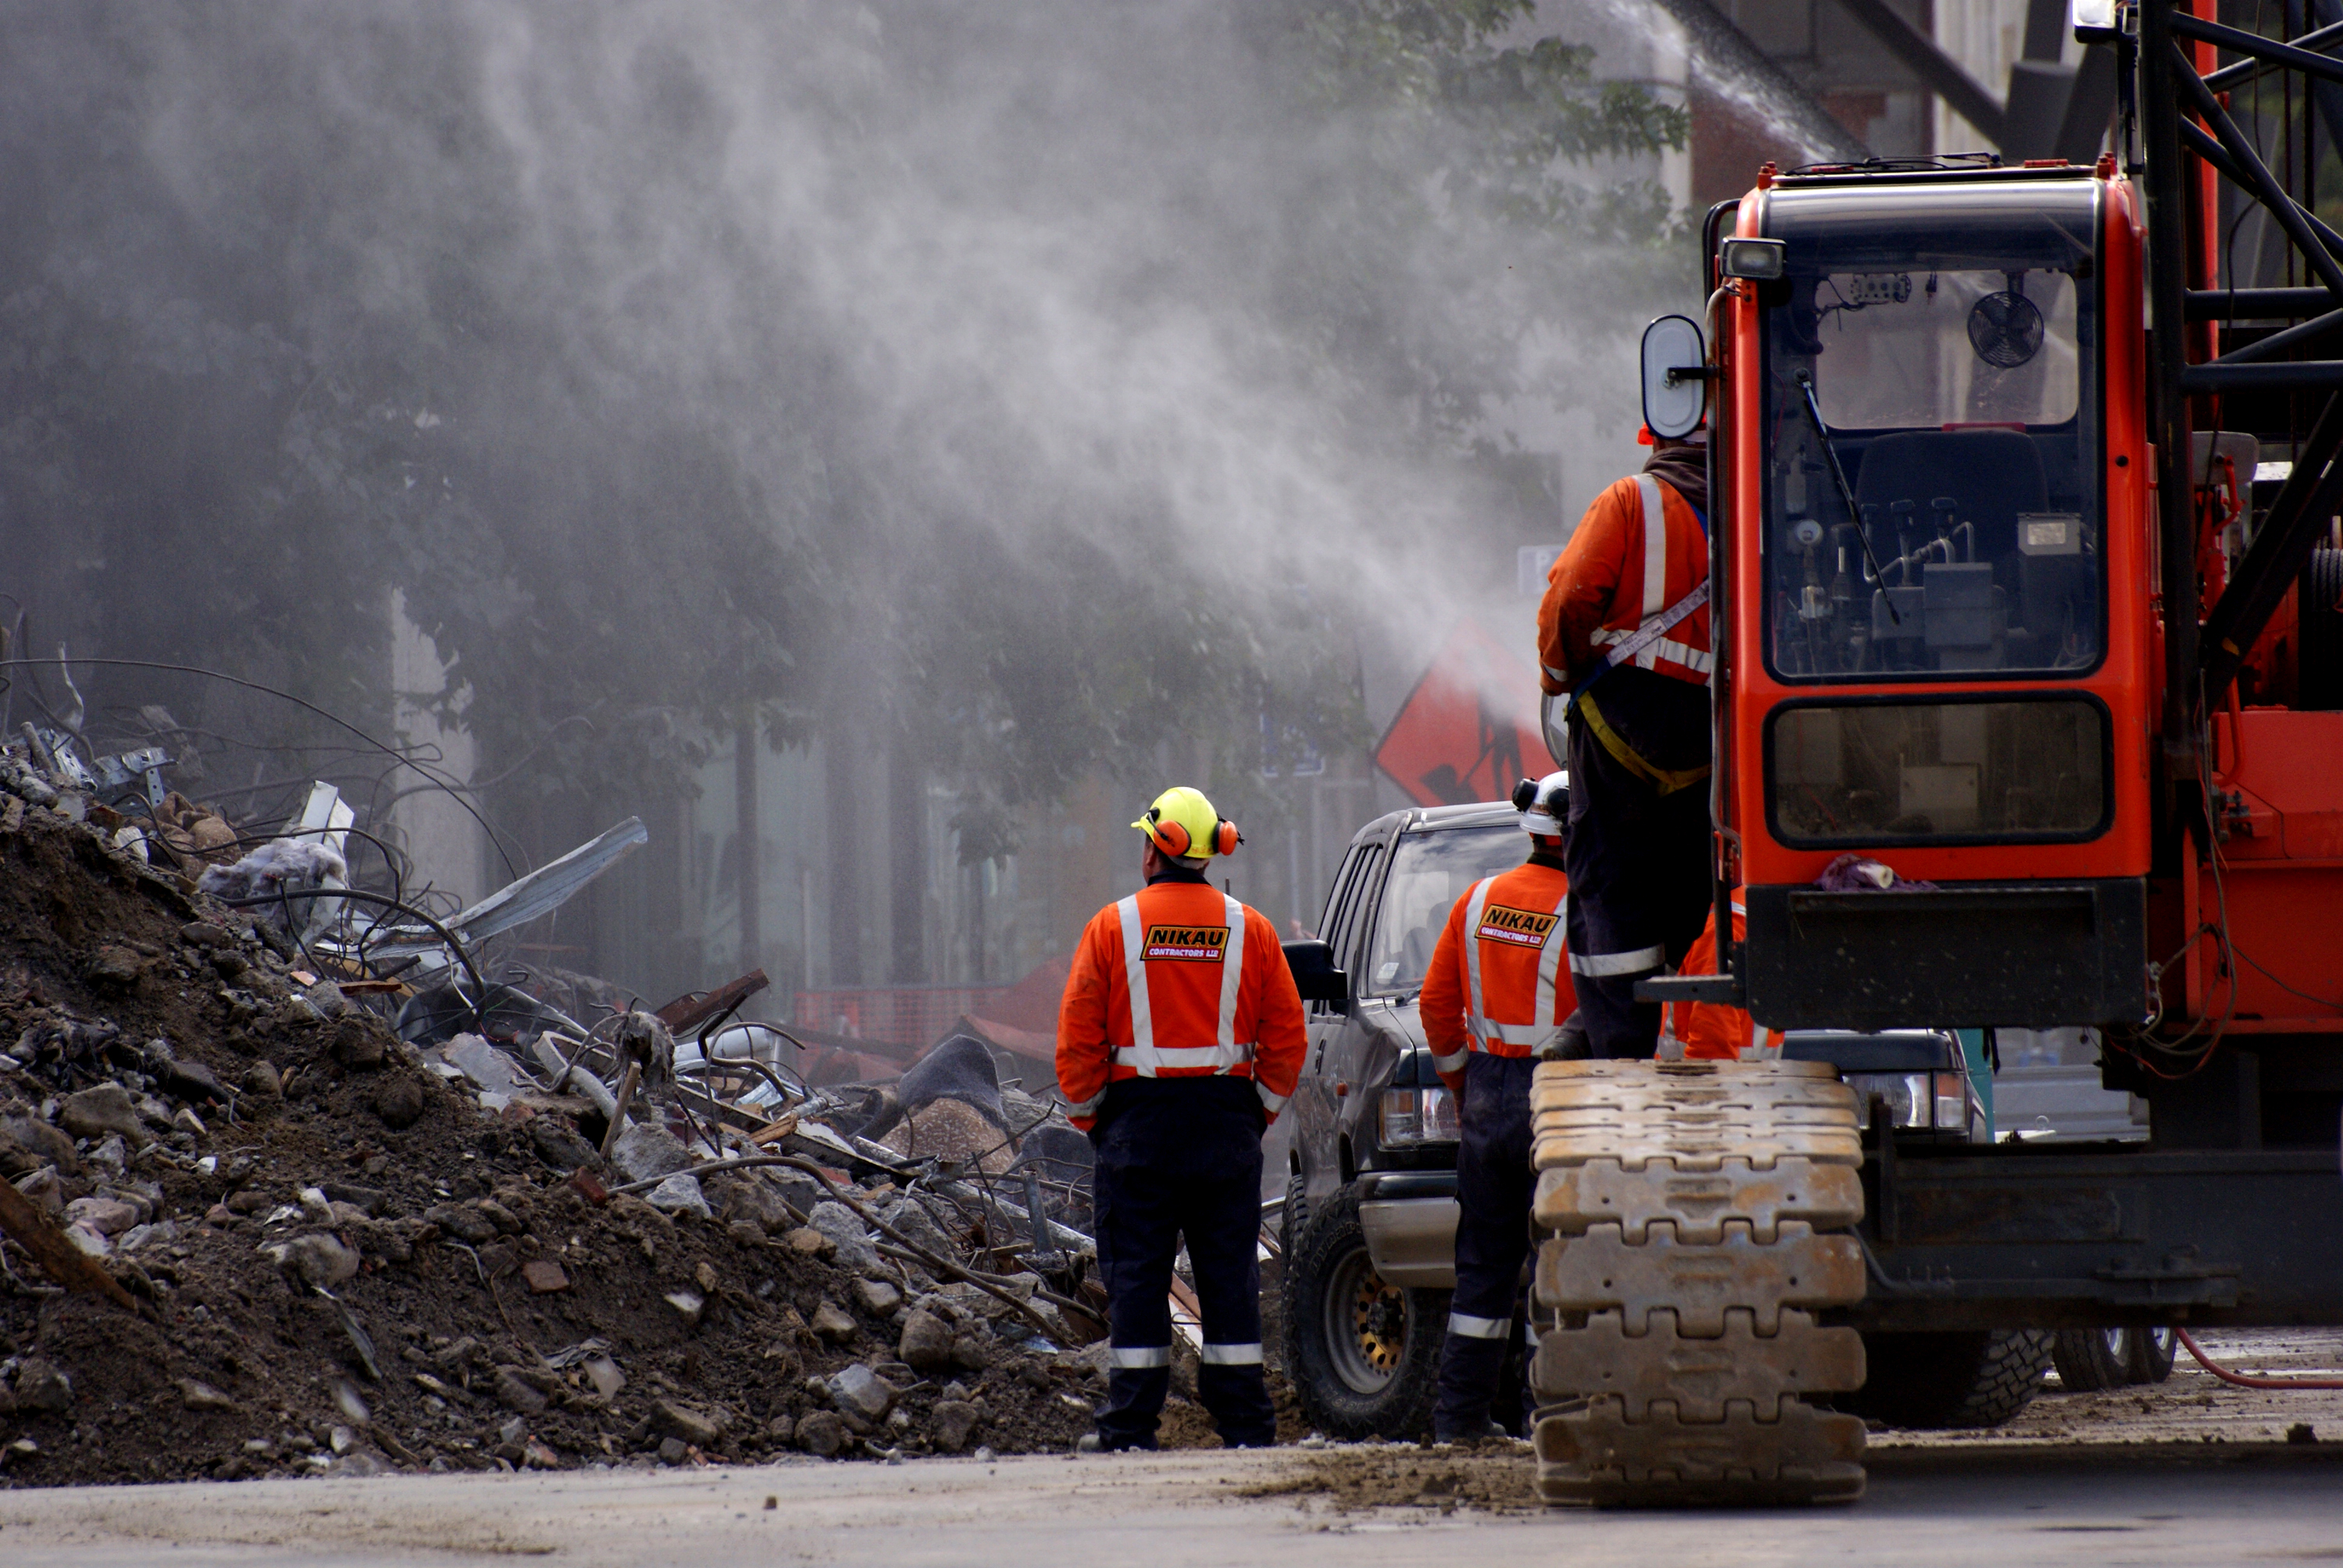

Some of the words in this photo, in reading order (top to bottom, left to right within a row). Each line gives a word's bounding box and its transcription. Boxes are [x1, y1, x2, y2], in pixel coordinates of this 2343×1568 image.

[1535, 550, 1551, 575] P
[1486, 909, 1551, 932] NIKAU
[1152, 930, 1223, 946] NIKAU
[1482, 927, 1528, 942] CONTRACTORS
[1149, 948, 1204, 957] CONTRACTORS
